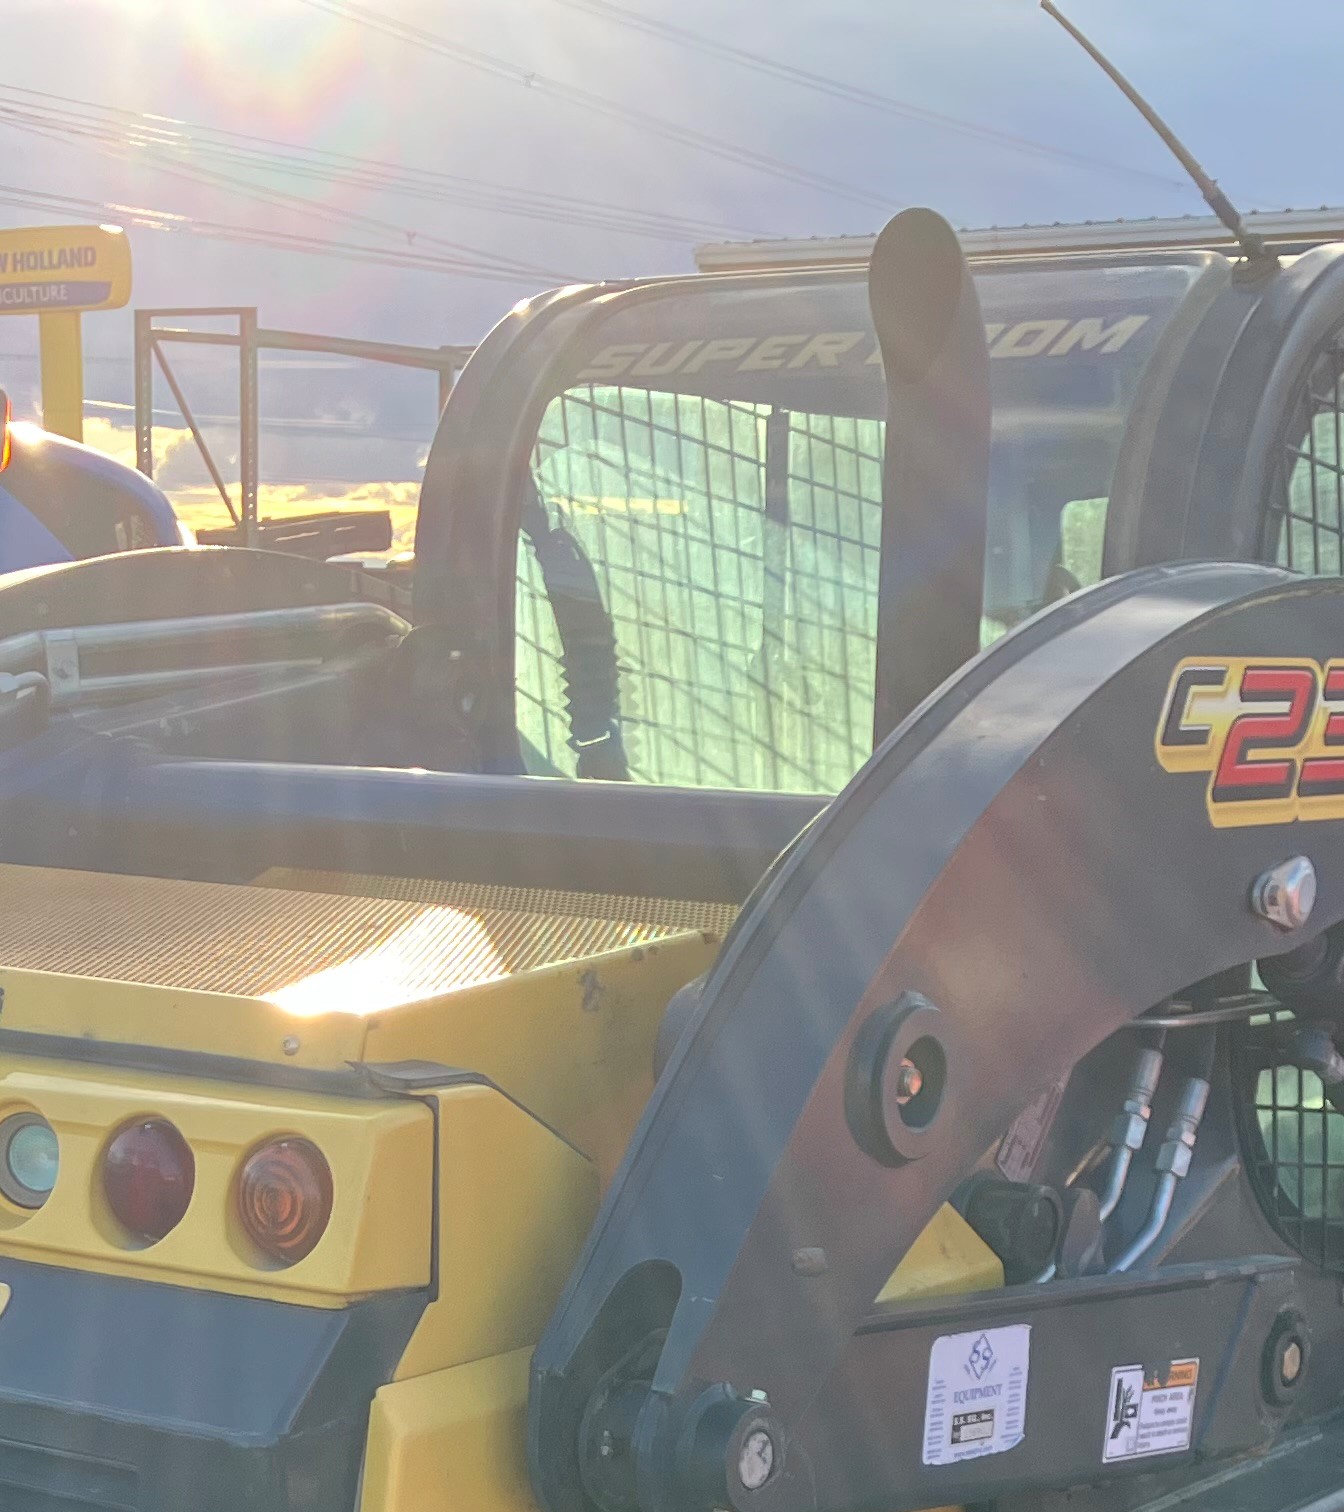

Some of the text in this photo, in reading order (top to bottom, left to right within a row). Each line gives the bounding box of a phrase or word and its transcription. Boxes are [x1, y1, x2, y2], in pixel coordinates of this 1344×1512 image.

[11, 245, 97, 274] HOLLAND
[575, 314, 1153, 380] SUPER OM
[953, 1383, 1003, 1404] EQUIPMENT
